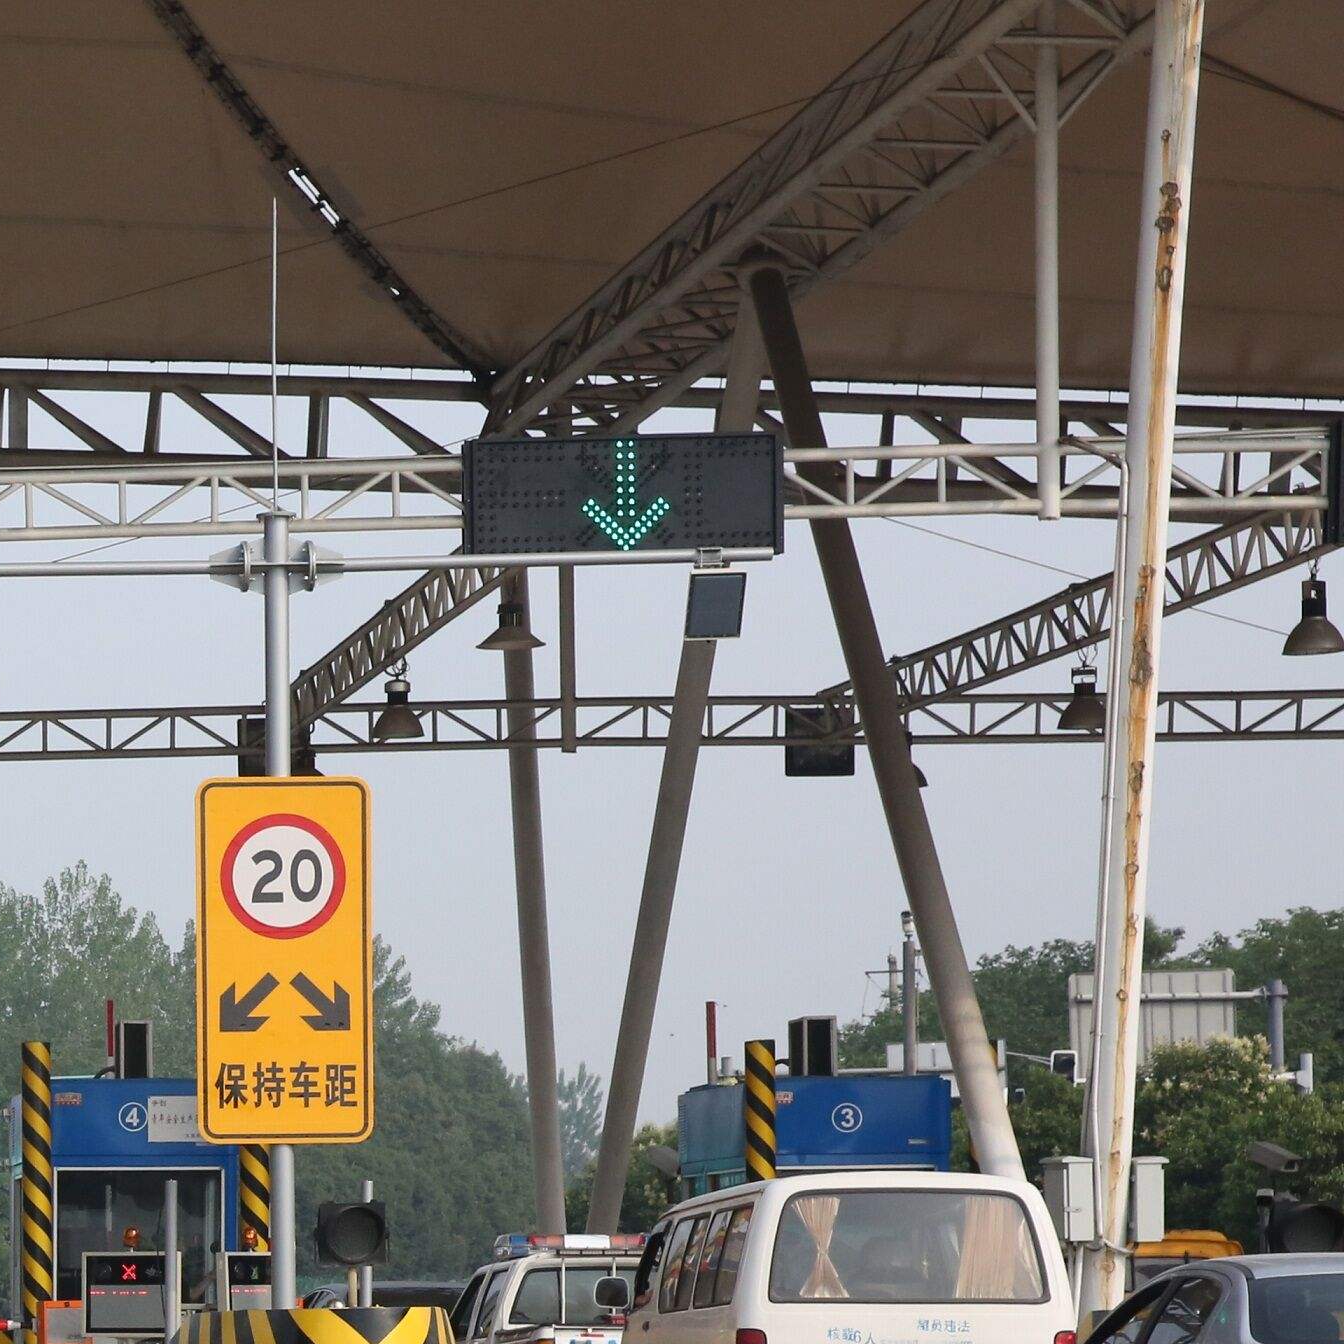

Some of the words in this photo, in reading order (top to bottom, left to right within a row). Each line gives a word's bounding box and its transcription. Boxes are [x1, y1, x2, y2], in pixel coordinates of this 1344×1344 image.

[251, 849, 322, 904] 20
[215, 1061, 358, 1108] 保持车距
